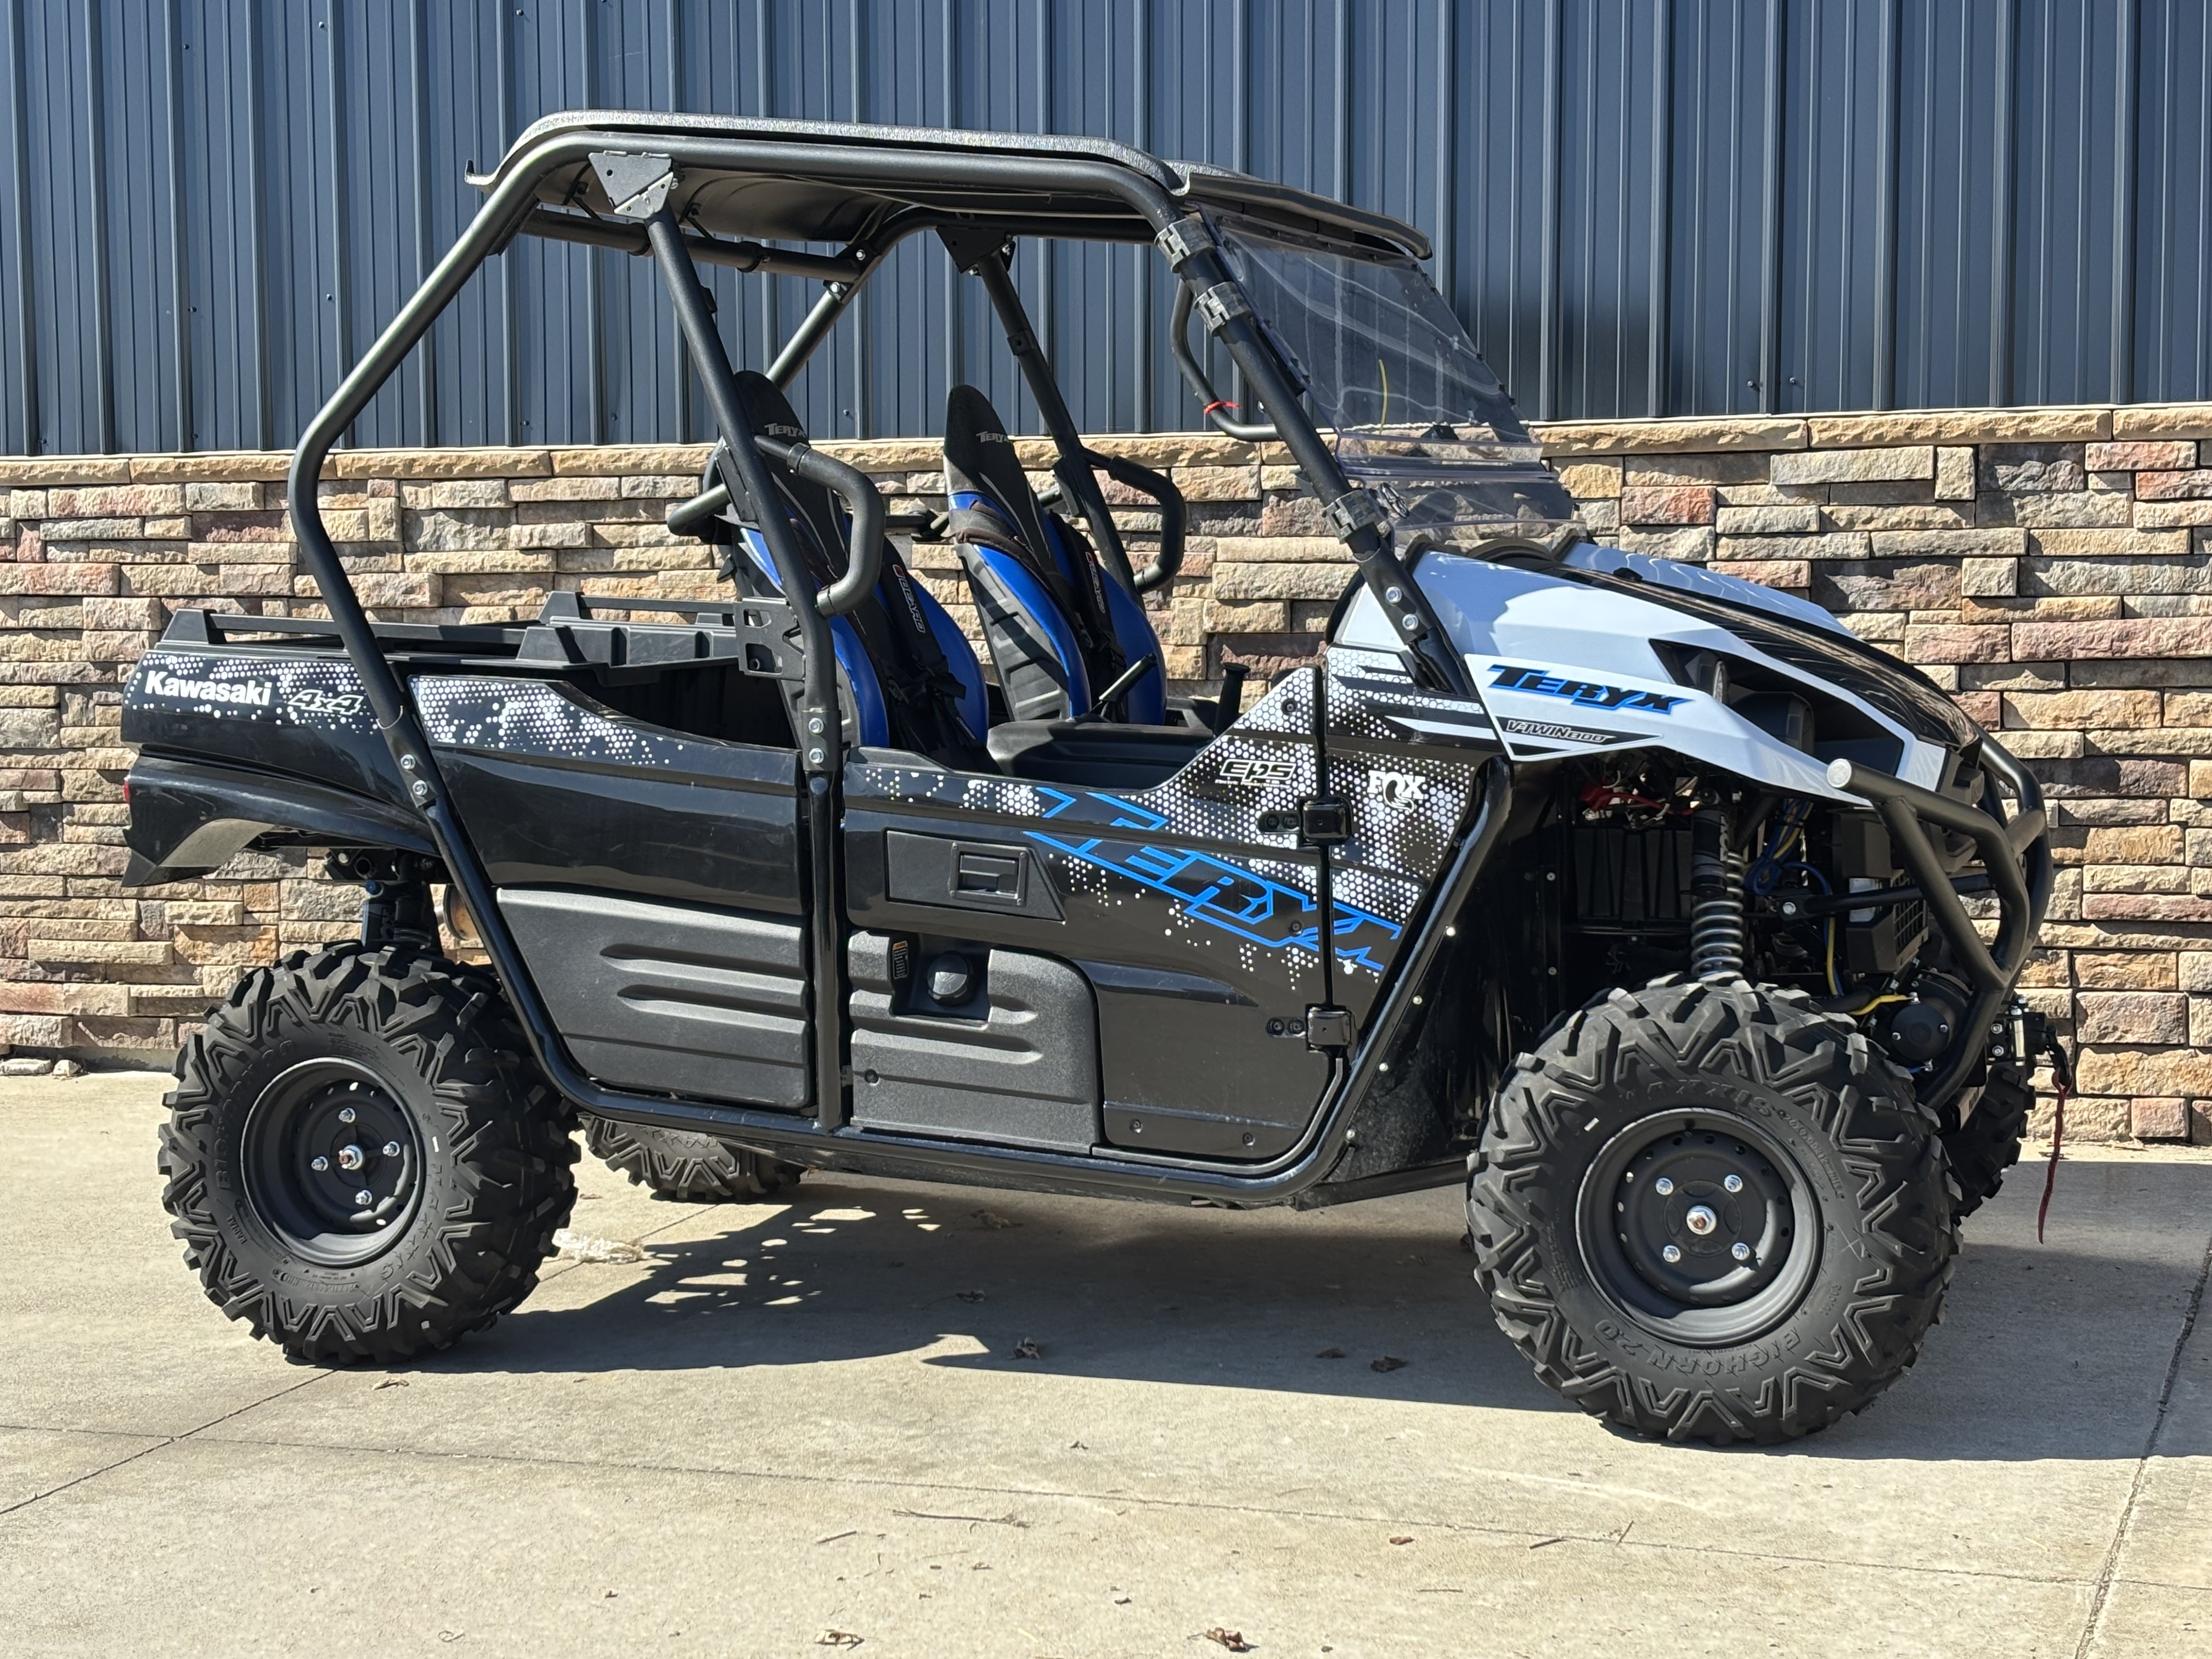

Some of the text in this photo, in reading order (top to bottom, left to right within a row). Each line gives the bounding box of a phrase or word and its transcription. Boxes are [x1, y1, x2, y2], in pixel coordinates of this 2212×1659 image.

[145, 670, 272, 706] Kawasaki
[288, 689, 364, 715] 4x4
[1482, 664, 1696, 715] TERYX
[1367, 770, 1426, 814] FOX
